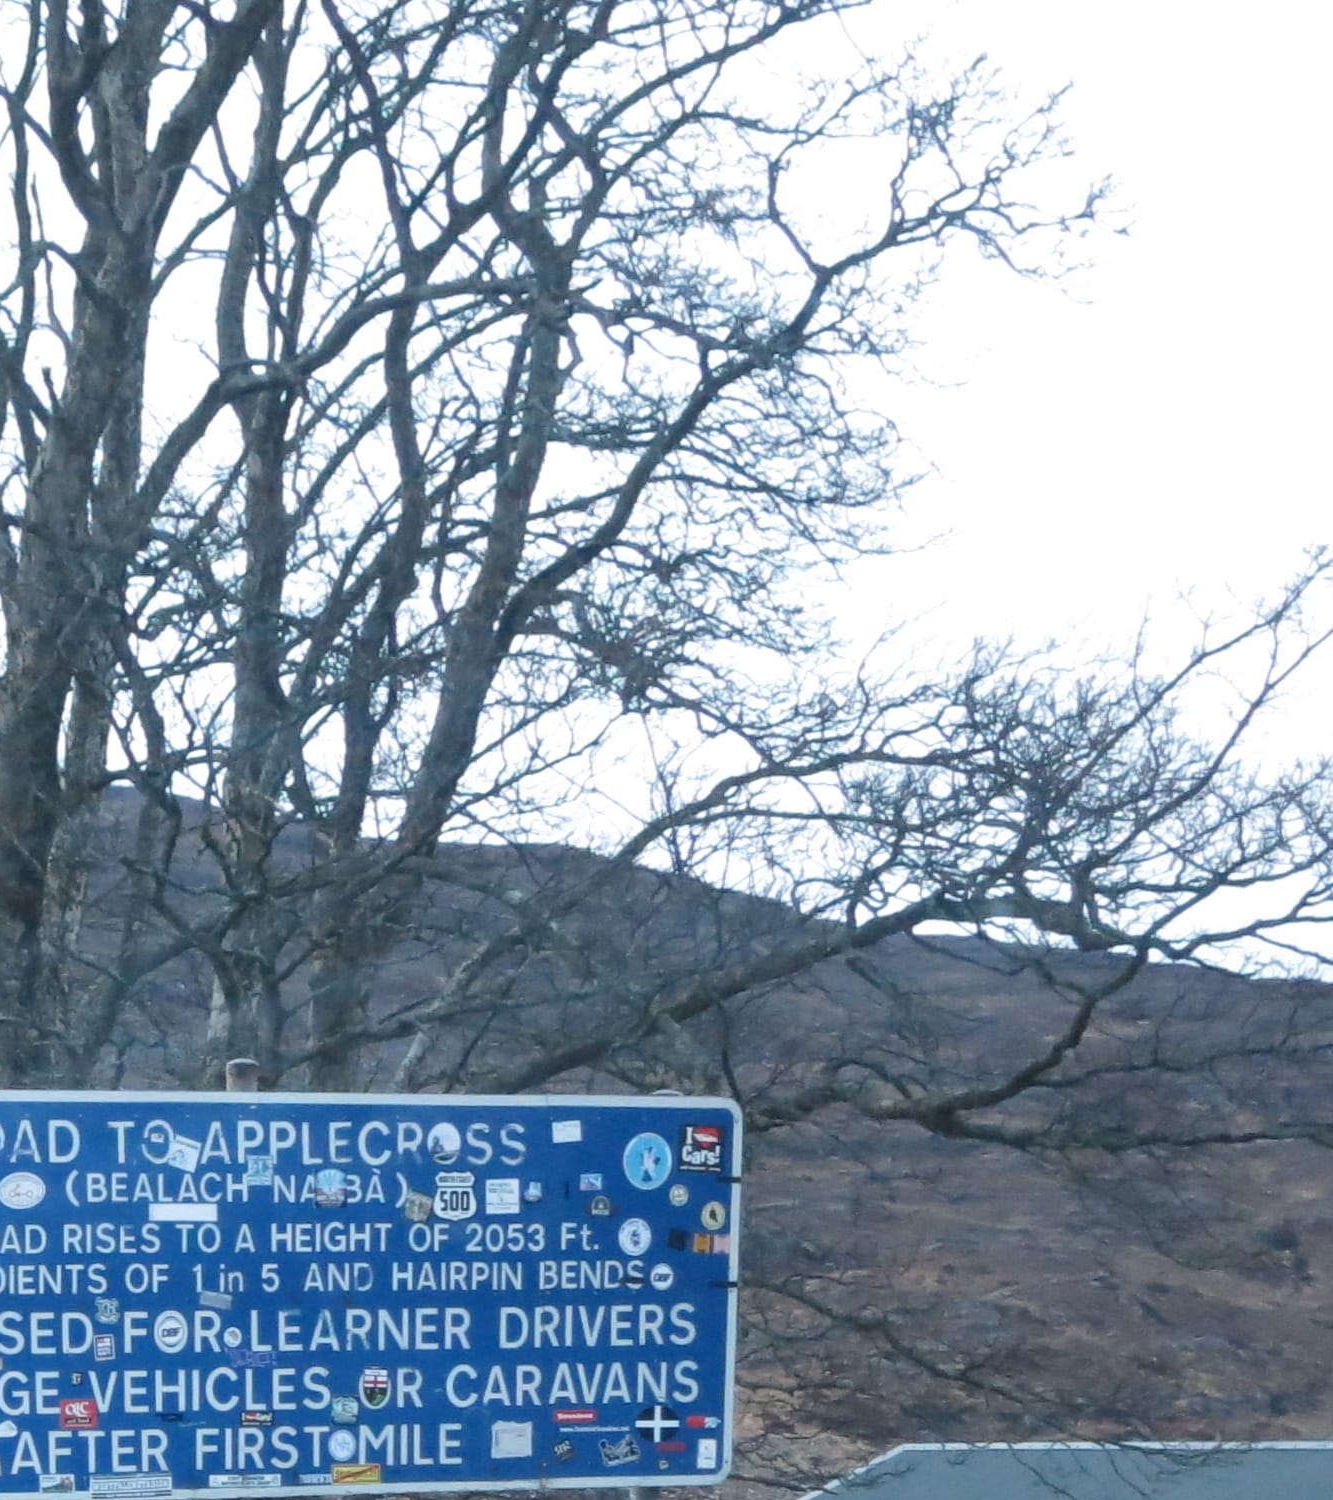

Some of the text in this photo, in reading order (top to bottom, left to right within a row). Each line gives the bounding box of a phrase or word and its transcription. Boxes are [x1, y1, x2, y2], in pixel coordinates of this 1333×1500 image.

[107, 1119, 175, 1165] TO
[200, 1120, 527, 1166] APPLECROSS
[681, 1144, 721, 1165] Cars!
[65, 1169, 249, 1207] (BEALACH
[440, 1190, 471, 1212] 500
[63, 1222, 162, 1254] RISES
[175, 1223, 222, 1254] TO
[234, 1223, 256, 1253] A
[270, 1221, 393, 1253] HEIGHT
[408, 1222, 450, 1253] OF
[464, 1222, 546, 1252] 2053
[560, 1221, 600, 1251] Ft.
[124, 1263, 170, 1294] OF
[192, 1263, 203, 1293] 1
[219, 1263, 244, 1293] in
[261, 1262, 281, 1293] 5
[303, 1261, 374, 1292] AND
[391, 1260, 523, 1291] HAIRPIN
[538, 1259, 646, 1290] BENDS
[123, 1309, 222, 1354] FOR
[249, 1306, 472, 1352] LEARNER
[498, 1302, 697, 1350] DRIVERS
[88, 1366, 332, 1414] VEHICLES
[358, 1365, 424, 1410] OR
[445, 1359, 700, 1408] CARAVANS
[10, 1422, 463, 1476] AFTER FIRST MILE
